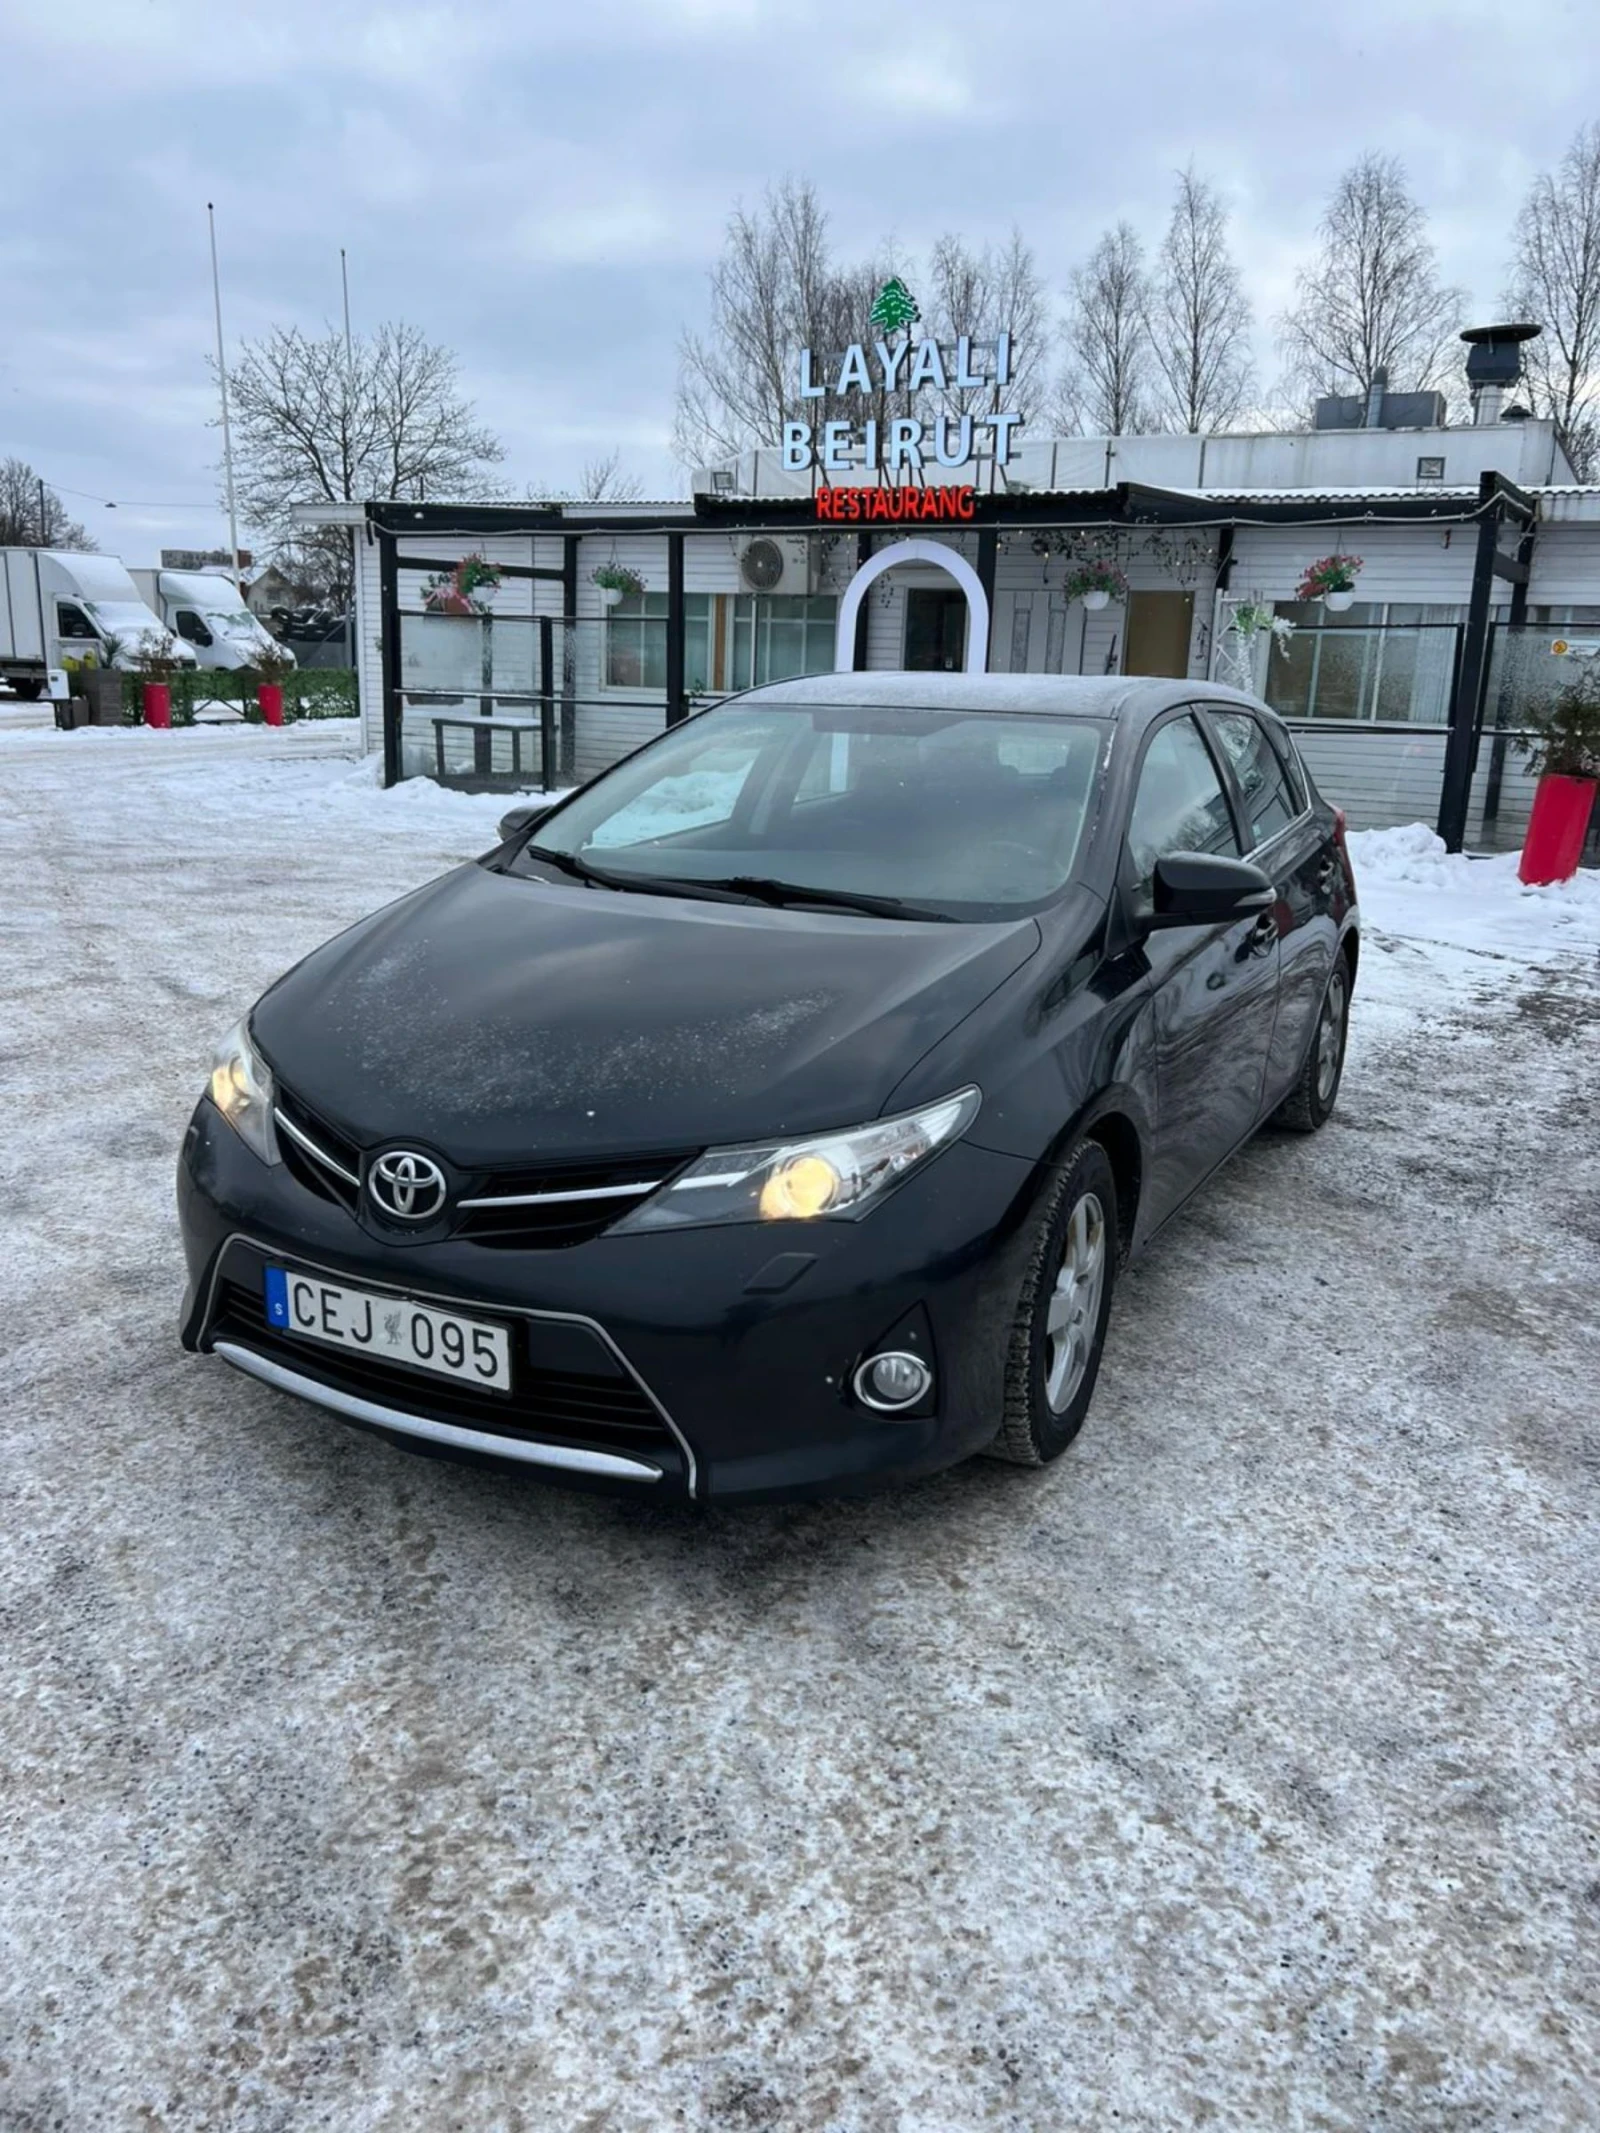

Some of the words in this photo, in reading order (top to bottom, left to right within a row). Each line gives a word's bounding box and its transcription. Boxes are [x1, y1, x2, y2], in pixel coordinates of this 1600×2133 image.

[800, 332, 1010, 398] LAYALI
[782, 412, 1022, 471] BEIRUT
[816, 485, 975, 519] RESTAURANG
[275, 1302, 283, 1316] S
[293, 1281, 373, 1344] CEJ
[410, 1312, 499, 1378] 095
